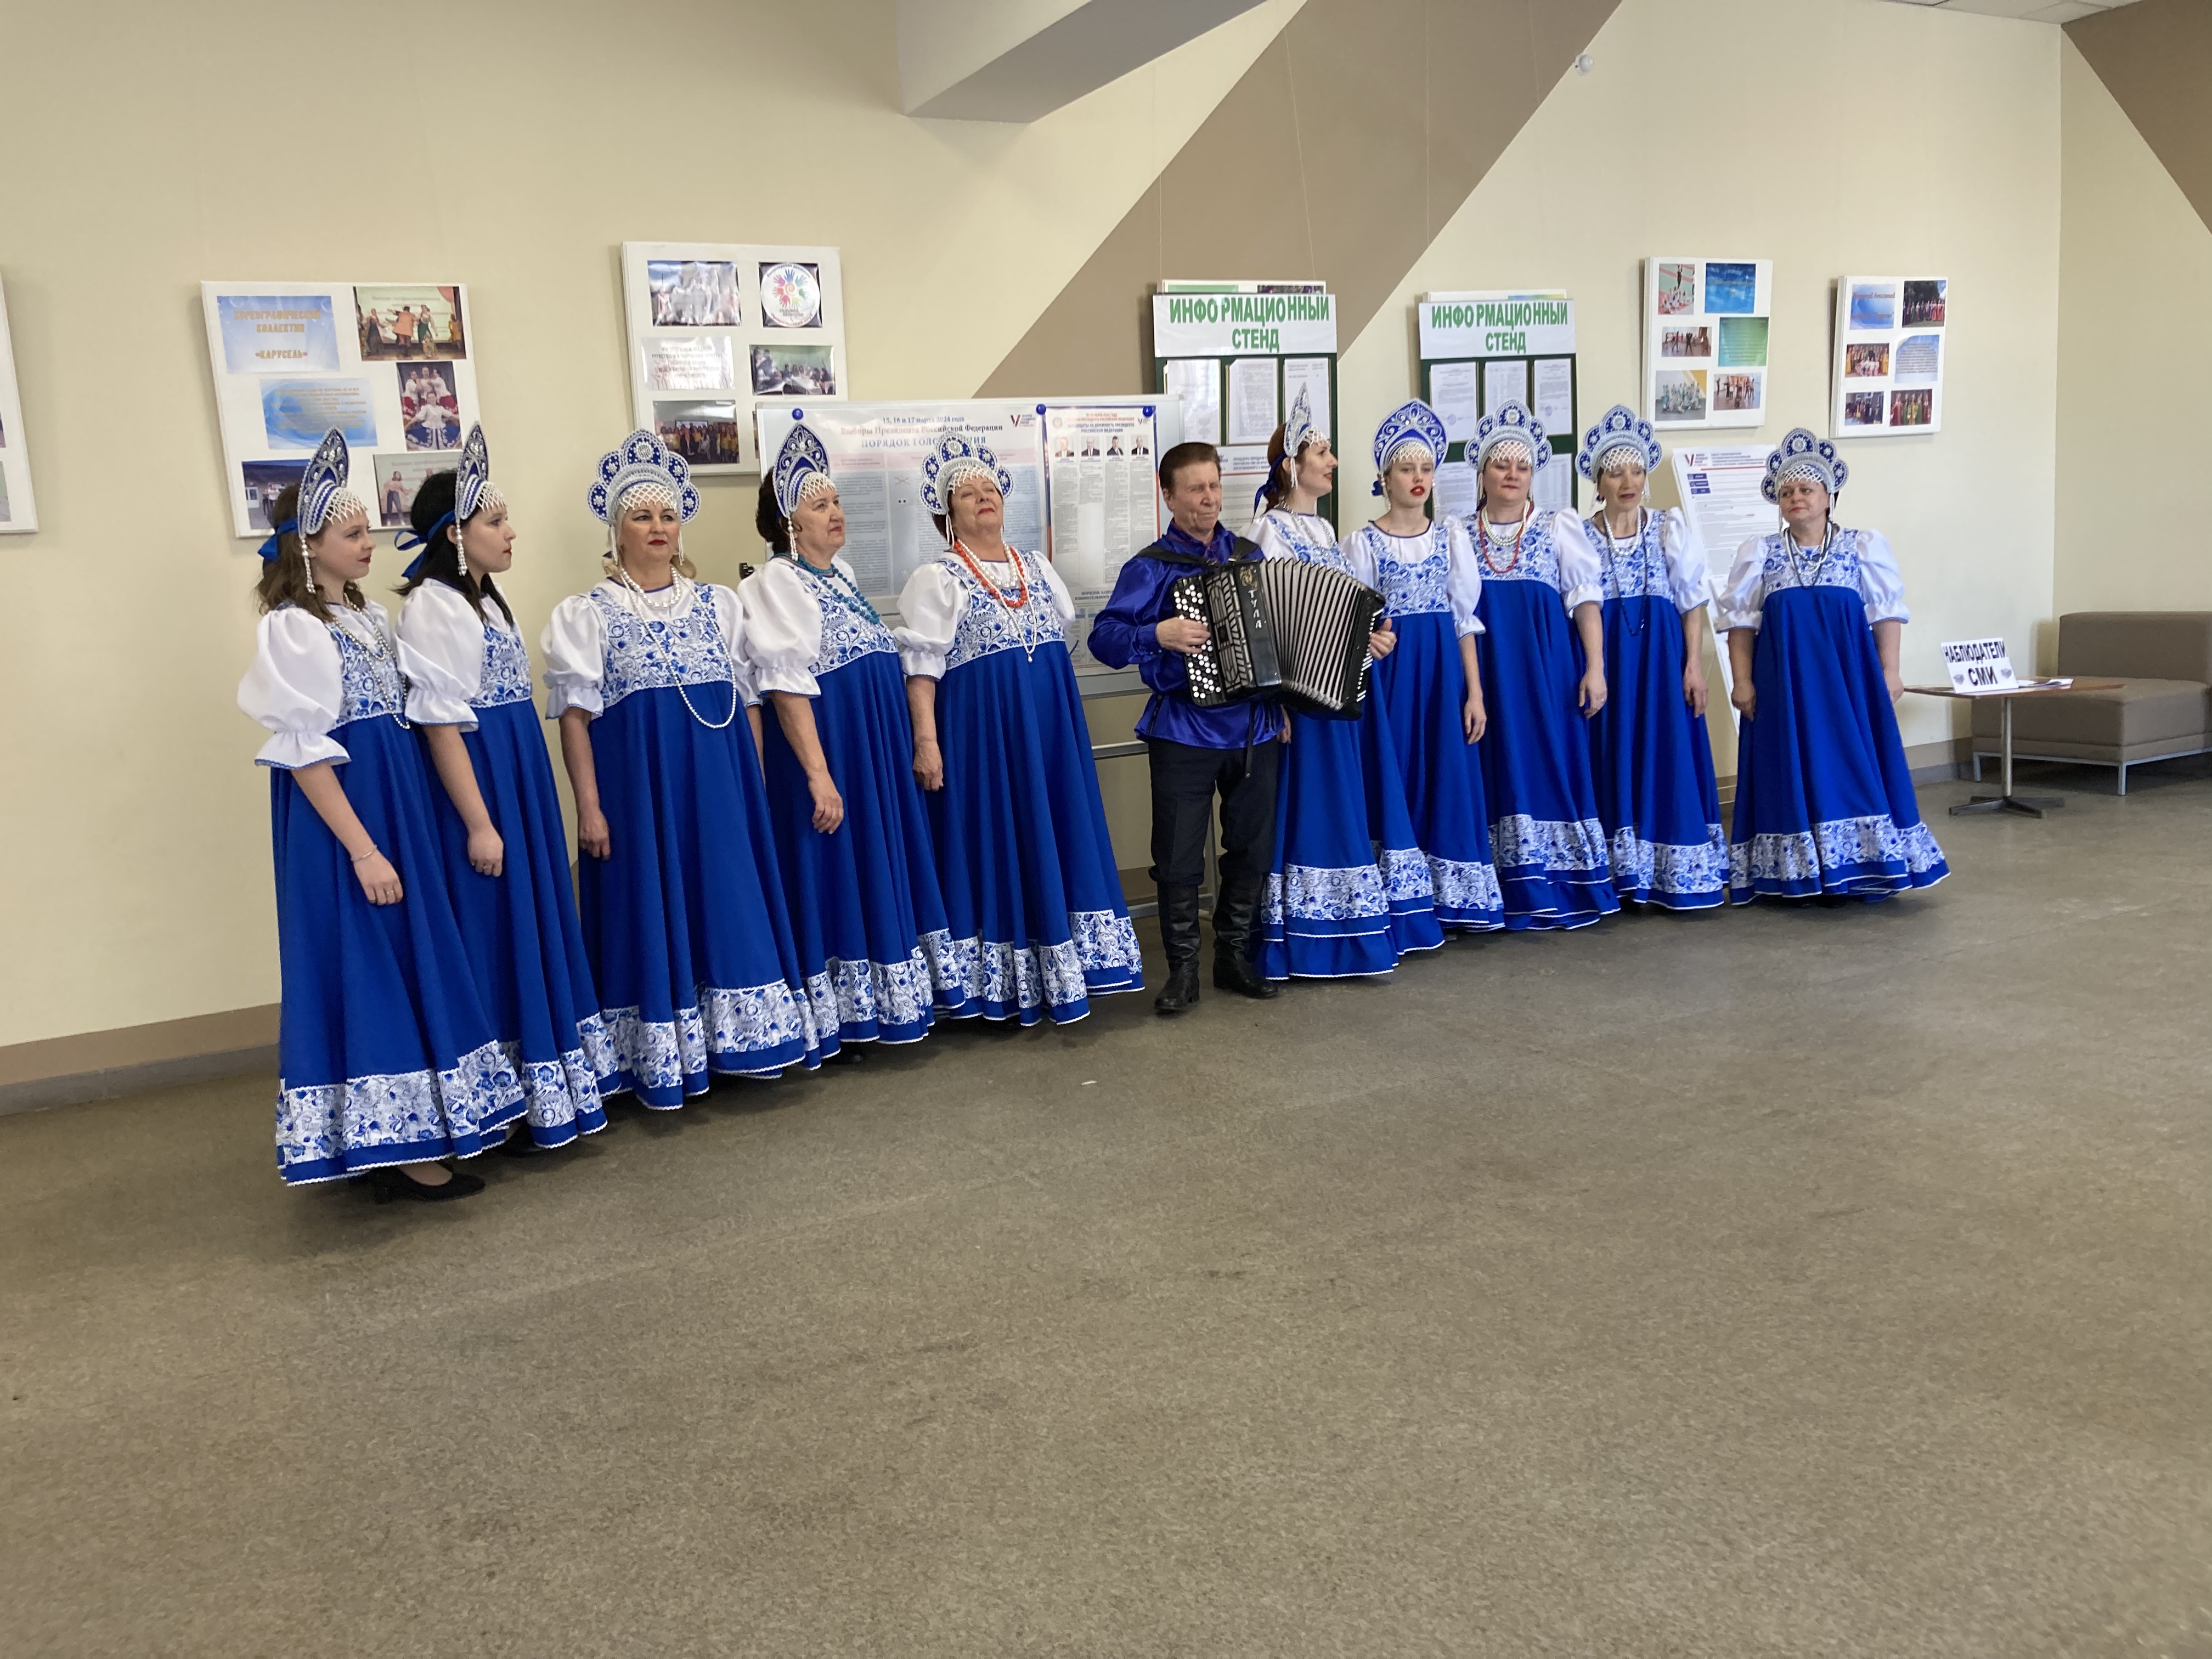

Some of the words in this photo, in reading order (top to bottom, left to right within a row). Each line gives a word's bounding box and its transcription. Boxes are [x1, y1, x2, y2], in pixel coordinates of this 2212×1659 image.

[1232, 328, 1280, 352] СТЕНД
[1485, 331, 1526, 353] СТЕНД
[841, 427, 873, 436] Выборы
[875, 426, 919, 436] Президента
[921, 425, 963, 433] Российской
[965, 424, 1003, 433] Федерации
[861, 438, 910, 448] ПОРЯДОК
[1248, 589, 1262, 629] ТУЛА
[1943, 641, 2005, 664] НАБЛЮДАТЕЛИ
[1968, 666, 1998, 686] СМИ
